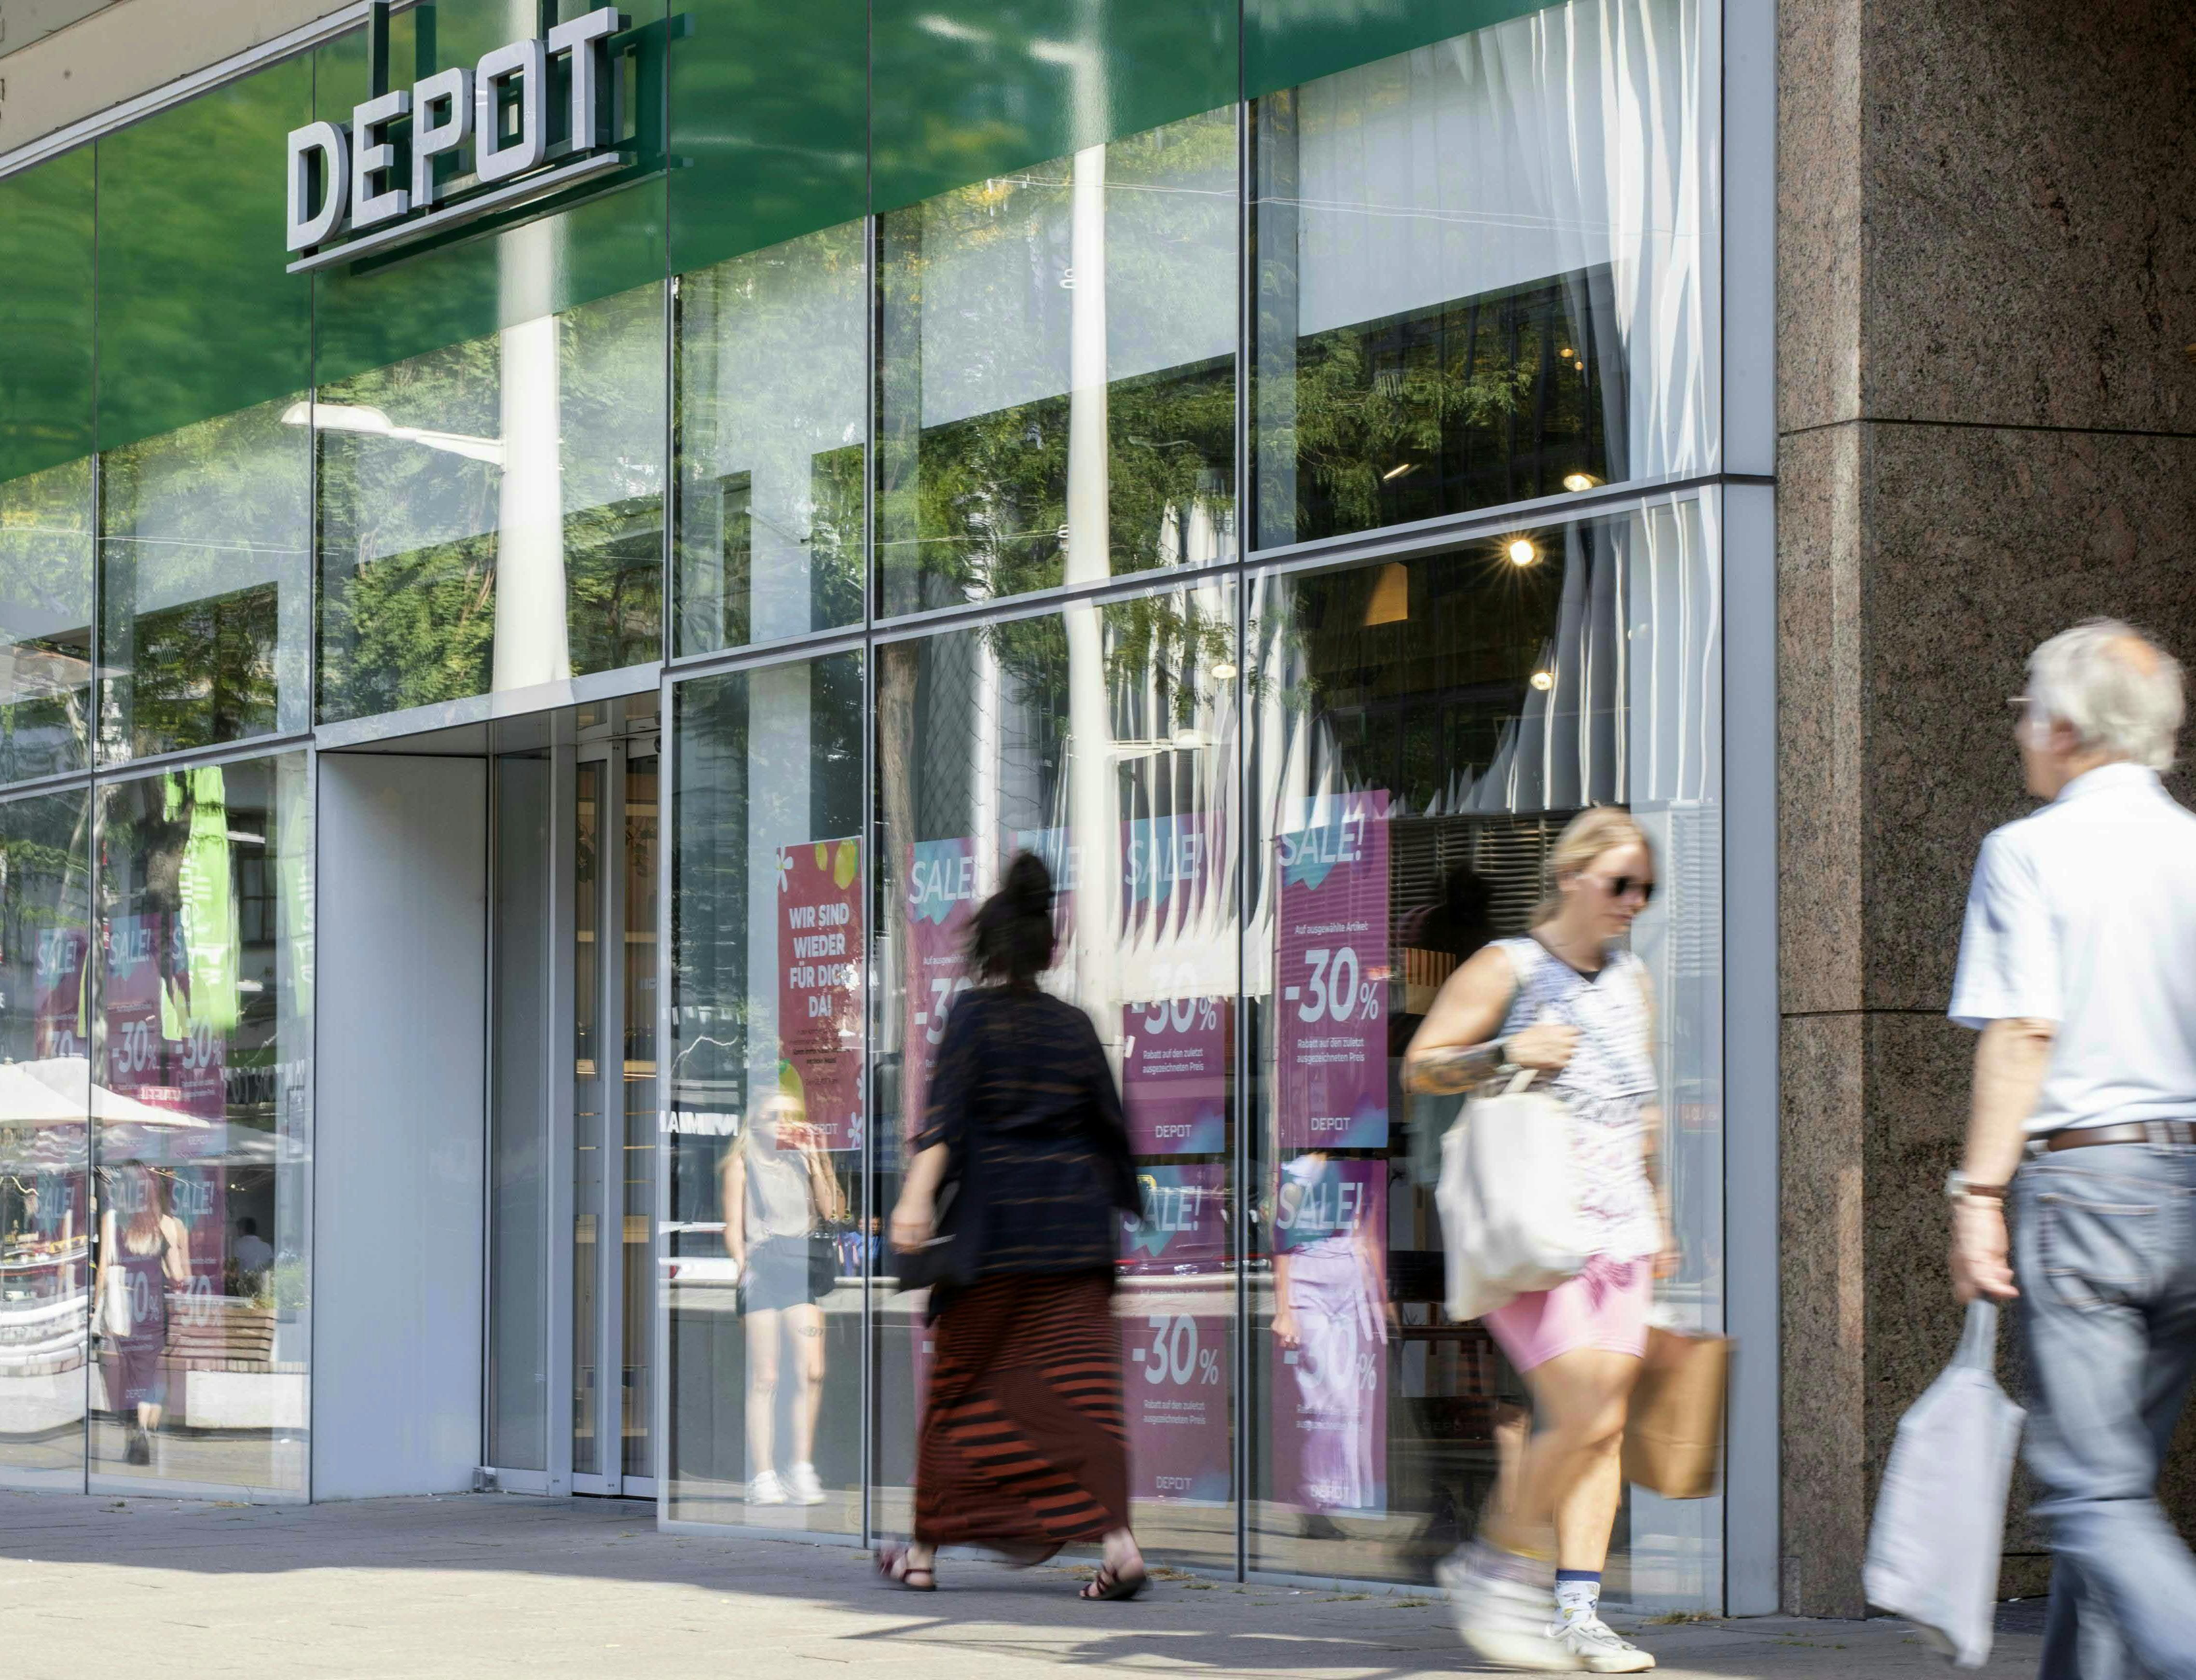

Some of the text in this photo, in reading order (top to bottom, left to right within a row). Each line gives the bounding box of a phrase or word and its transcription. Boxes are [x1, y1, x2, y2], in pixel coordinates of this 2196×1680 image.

[287, 7, 618, 251] DEPOT
[1278, 812, 1365, 867] SALE!
[1125, 832, 1204, 885] SALE!
[789, 903, 850, 929] WIR SIND
[1295, 916, 1369, 936] Auf ausgewählte Artikel
[109, 928, 151, 965] SALE!
[793, 933, 846, 959] WIEDER
[790, 961, 815, 989] FÜR
[1285, 947, 1379, 1023] -30%
[809, 995, 832, 1018] DA!
[1143, 1047, 1204, 1059] Rabatt auf den zuletzt
[1297, 1038, 1318, 1048] Rabatt
[1330, 1037, 1342, 1048] den
[1343, 1037, 1365, 1047] zuletzt
[1142, 1060, 1205, 1075] ausgezeichneten Preis
[1296, 1051, 1365, 1065] ausgezeichneten Preis
[1155, 1125, 1192, 1138] DEPOT
[1311, 1117, 1351, 1130] DEPOT
[172, 1180, 215, 1216] SALE!
[1276, 1182, 1363, 1230] SALE!
[1132, 1312, 1219, 1385] -30%
[1156, 1476, 1192, 1490] DEPOT
